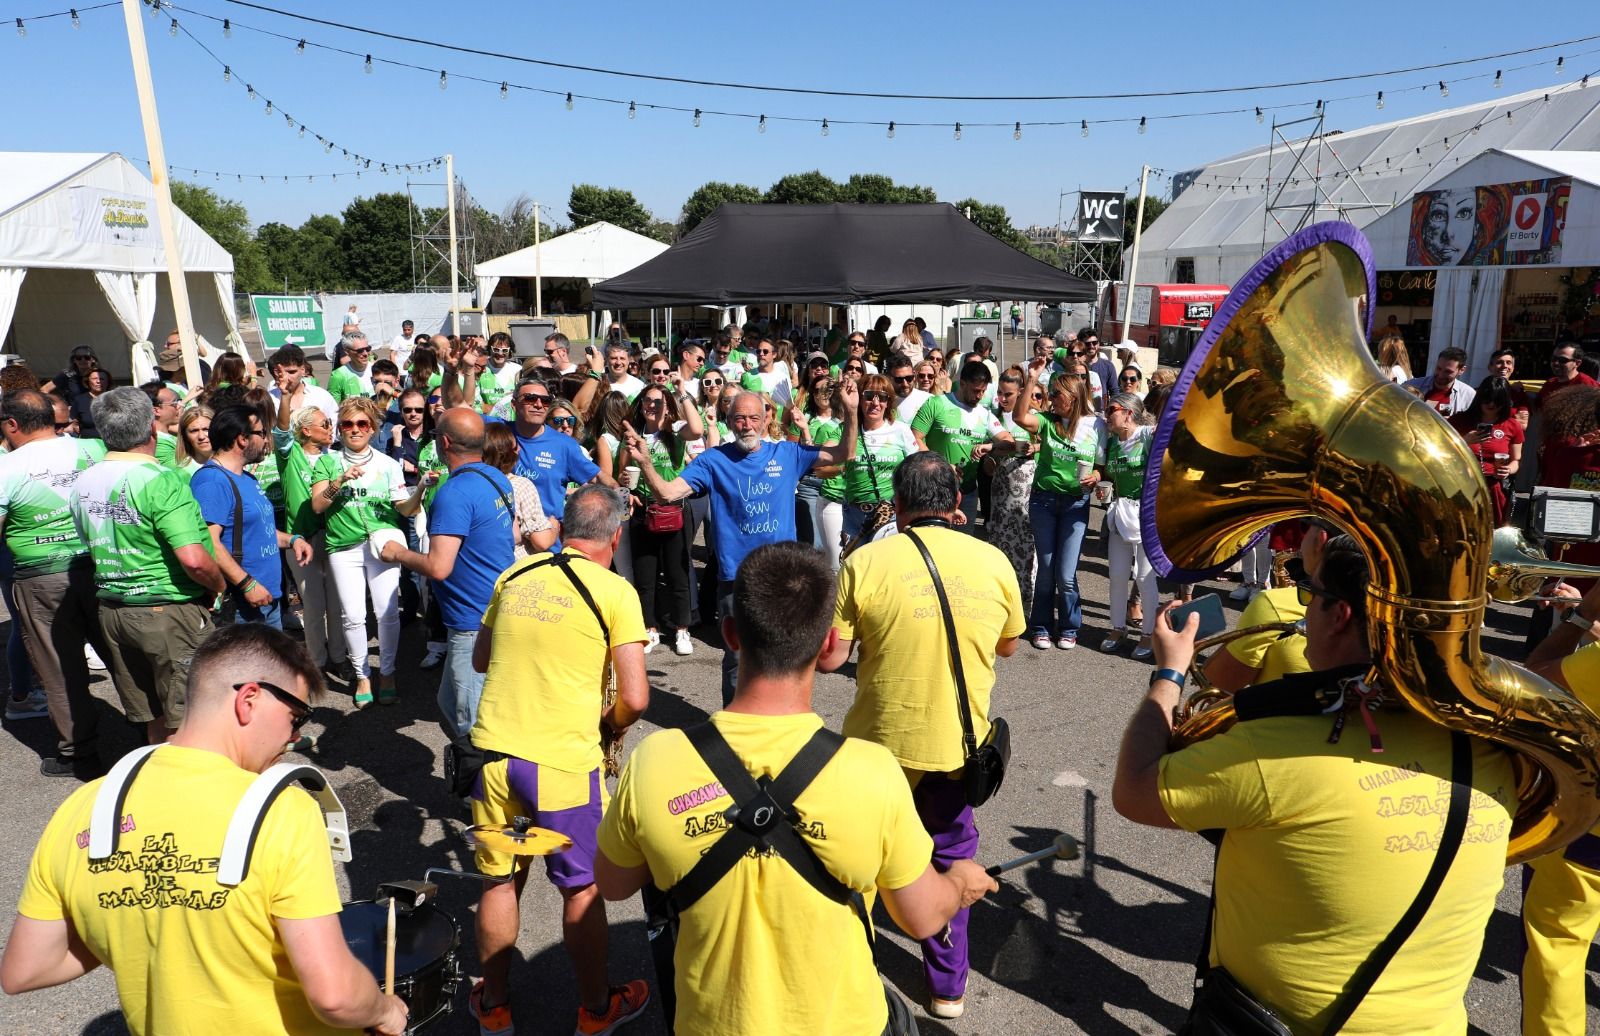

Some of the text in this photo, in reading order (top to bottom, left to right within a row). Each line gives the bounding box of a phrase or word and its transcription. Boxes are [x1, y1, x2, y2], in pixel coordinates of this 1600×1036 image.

[1084, 198, 1120, 219] WC
[1510, 231, 1540, 240] El Borty
[269, 300, 309, 313] SALIDA DE
[266, 317, 316, 331] EMERGENCIA
[737, 475, 773, 502] Vive
[33, 512, 49, 523] No
[745, 501, 770, 518] sin
[740, 512, 779, 535] miedo
[1358, 761, 1425, 792] CHARANGA
[142, 832, 179, 854] LA
[88, 851, 220, 875] ASAMBLE
[144, 870, 177, 890] DE
[98, 886, 230, 911] MAJARAS
